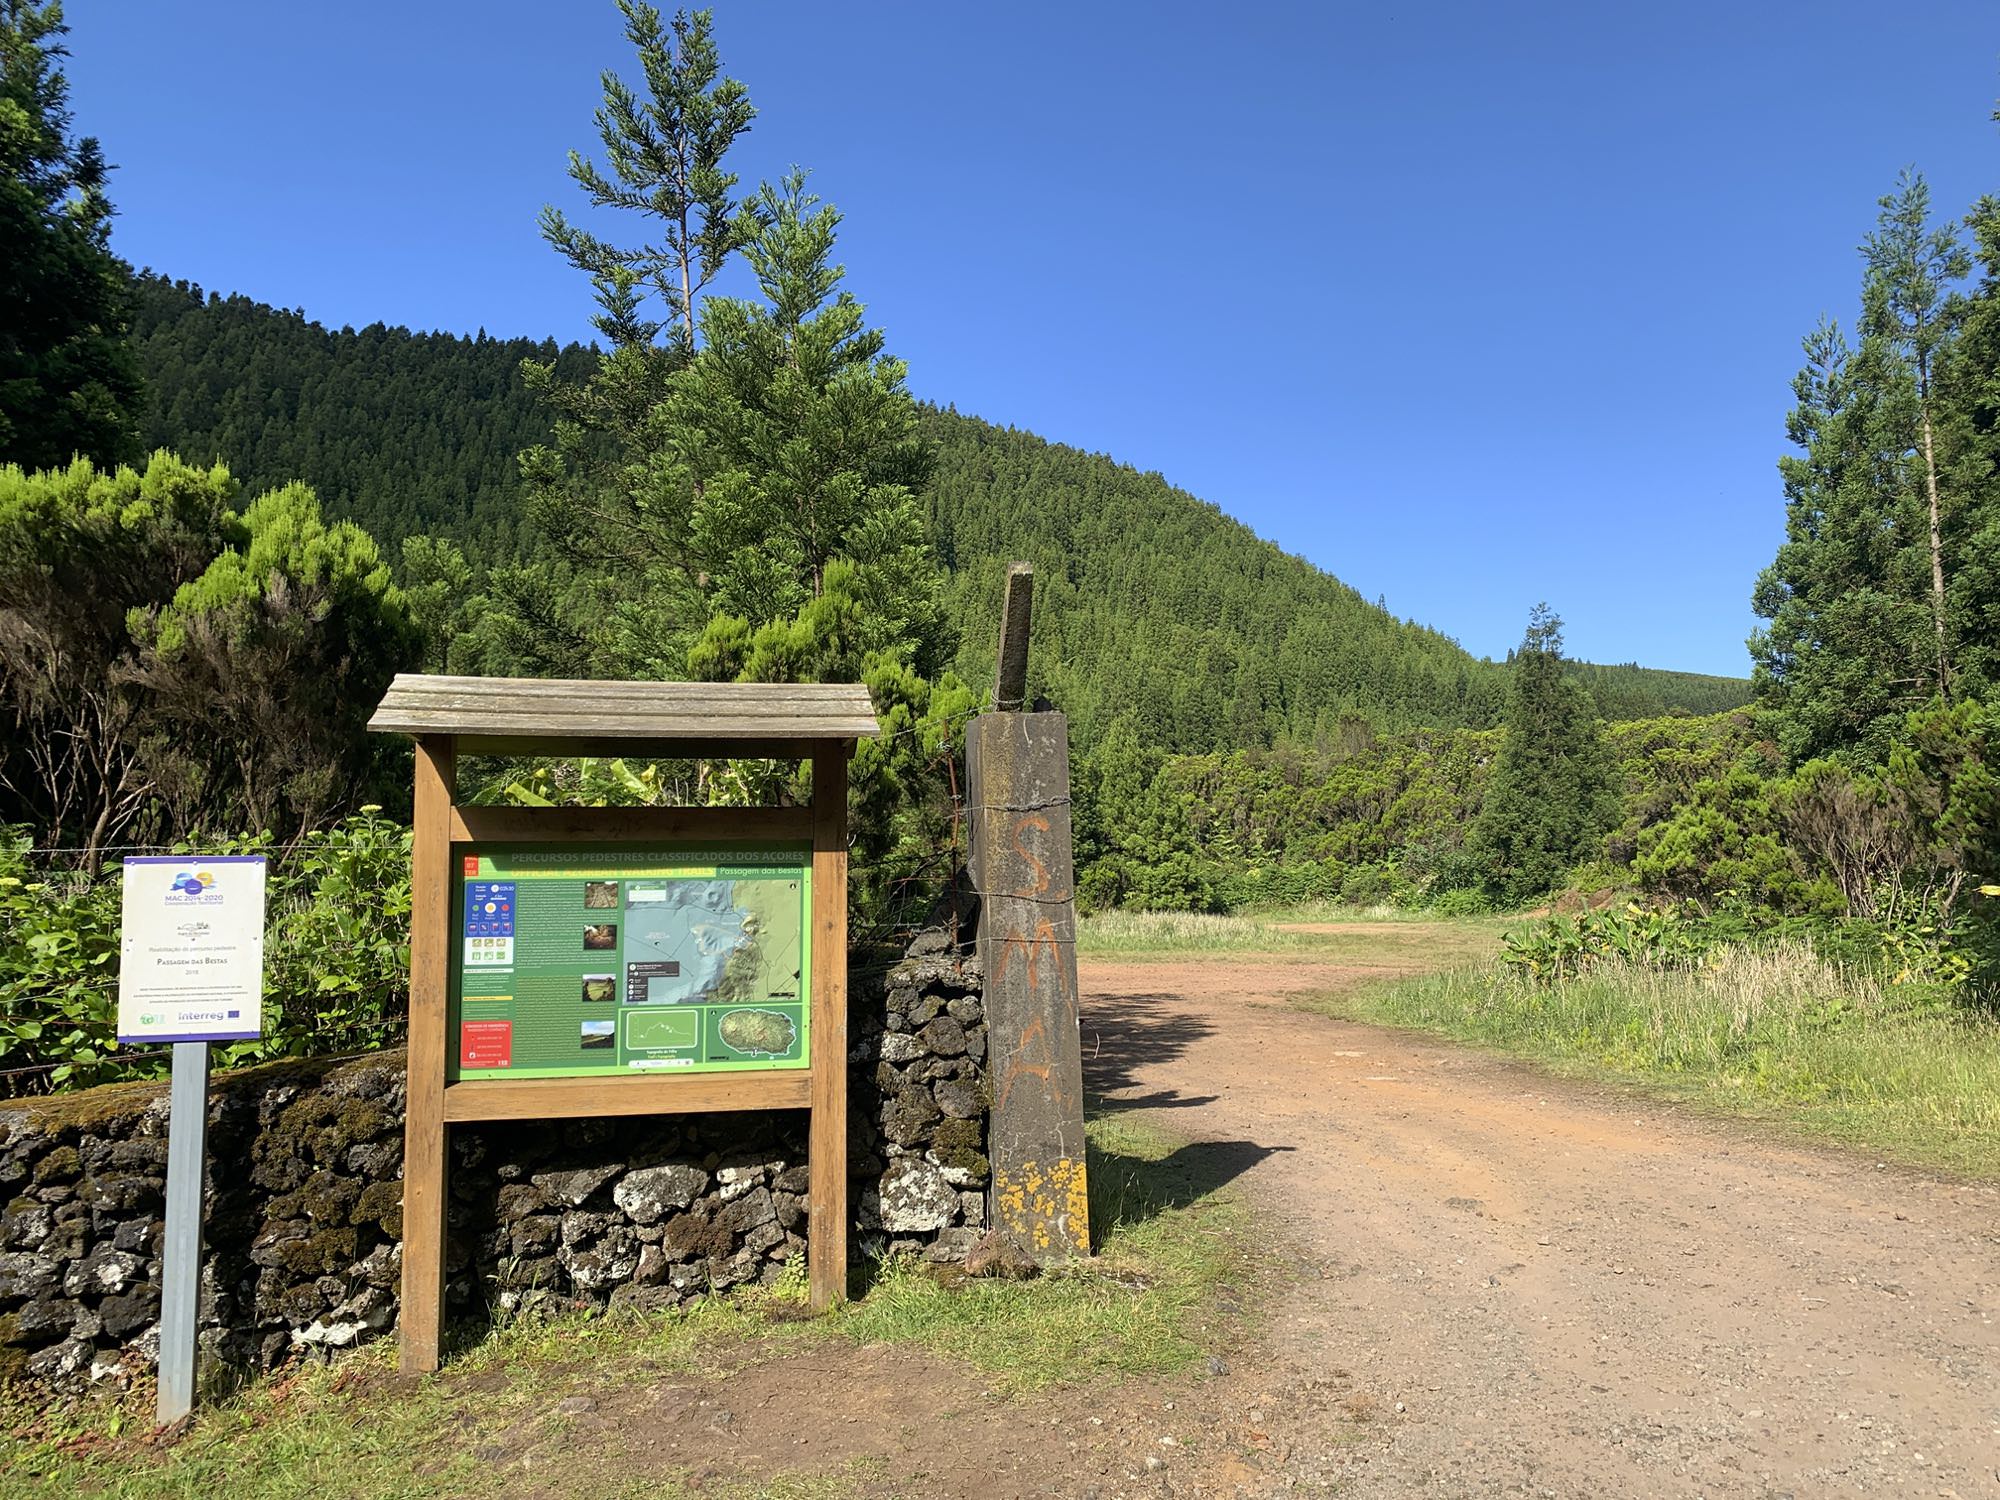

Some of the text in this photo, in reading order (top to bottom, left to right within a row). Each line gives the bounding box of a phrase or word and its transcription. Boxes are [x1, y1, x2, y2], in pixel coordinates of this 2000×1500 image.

[512, 851, 804, 862] PERCURSOS PEDESTRES CLASSIFICADOS DOS AÇORES
[720, 867, 759, 876] Passagem
